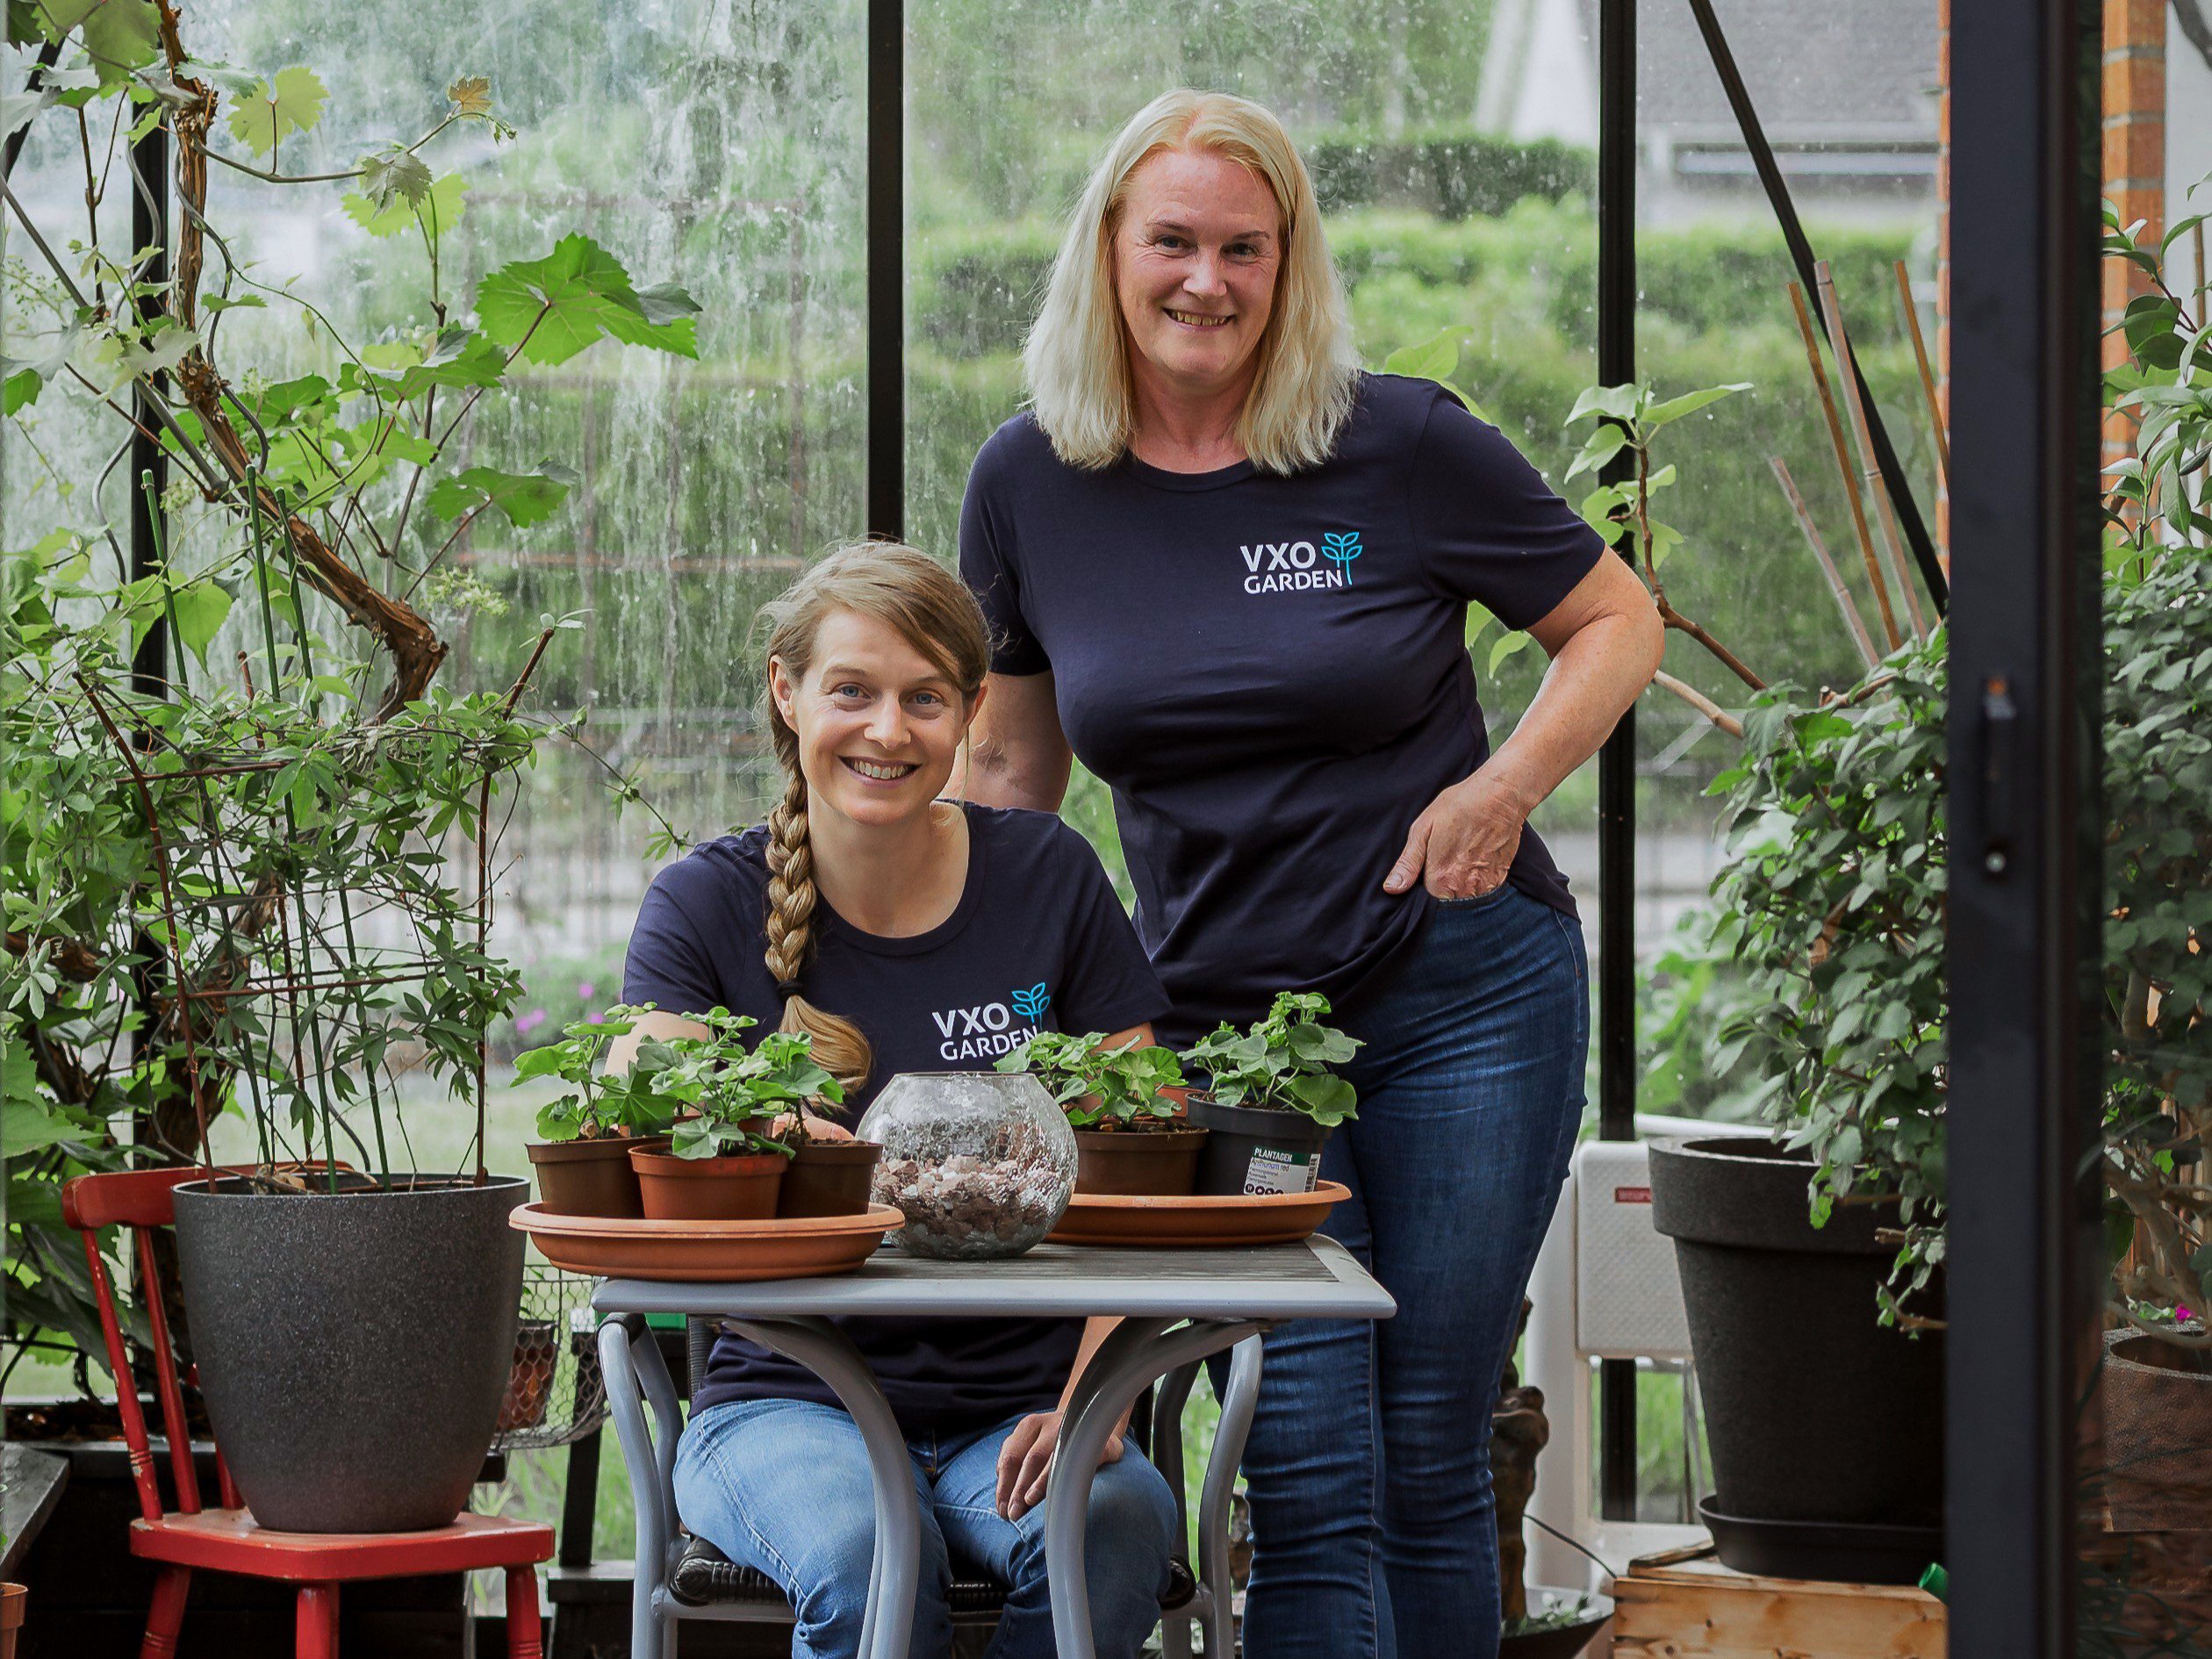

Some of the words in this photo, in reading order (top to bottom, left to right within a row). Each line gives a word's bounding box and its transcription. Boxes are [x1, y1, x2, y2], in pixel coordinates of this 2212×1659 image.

[1239, 541, 1317, 572] VXO
[1244, 569, 1343, 594] GARDEN
[931, 1002, 1010, 1038] VXO
[1253, 1147, 1293, 1163] PLANTAGEN
